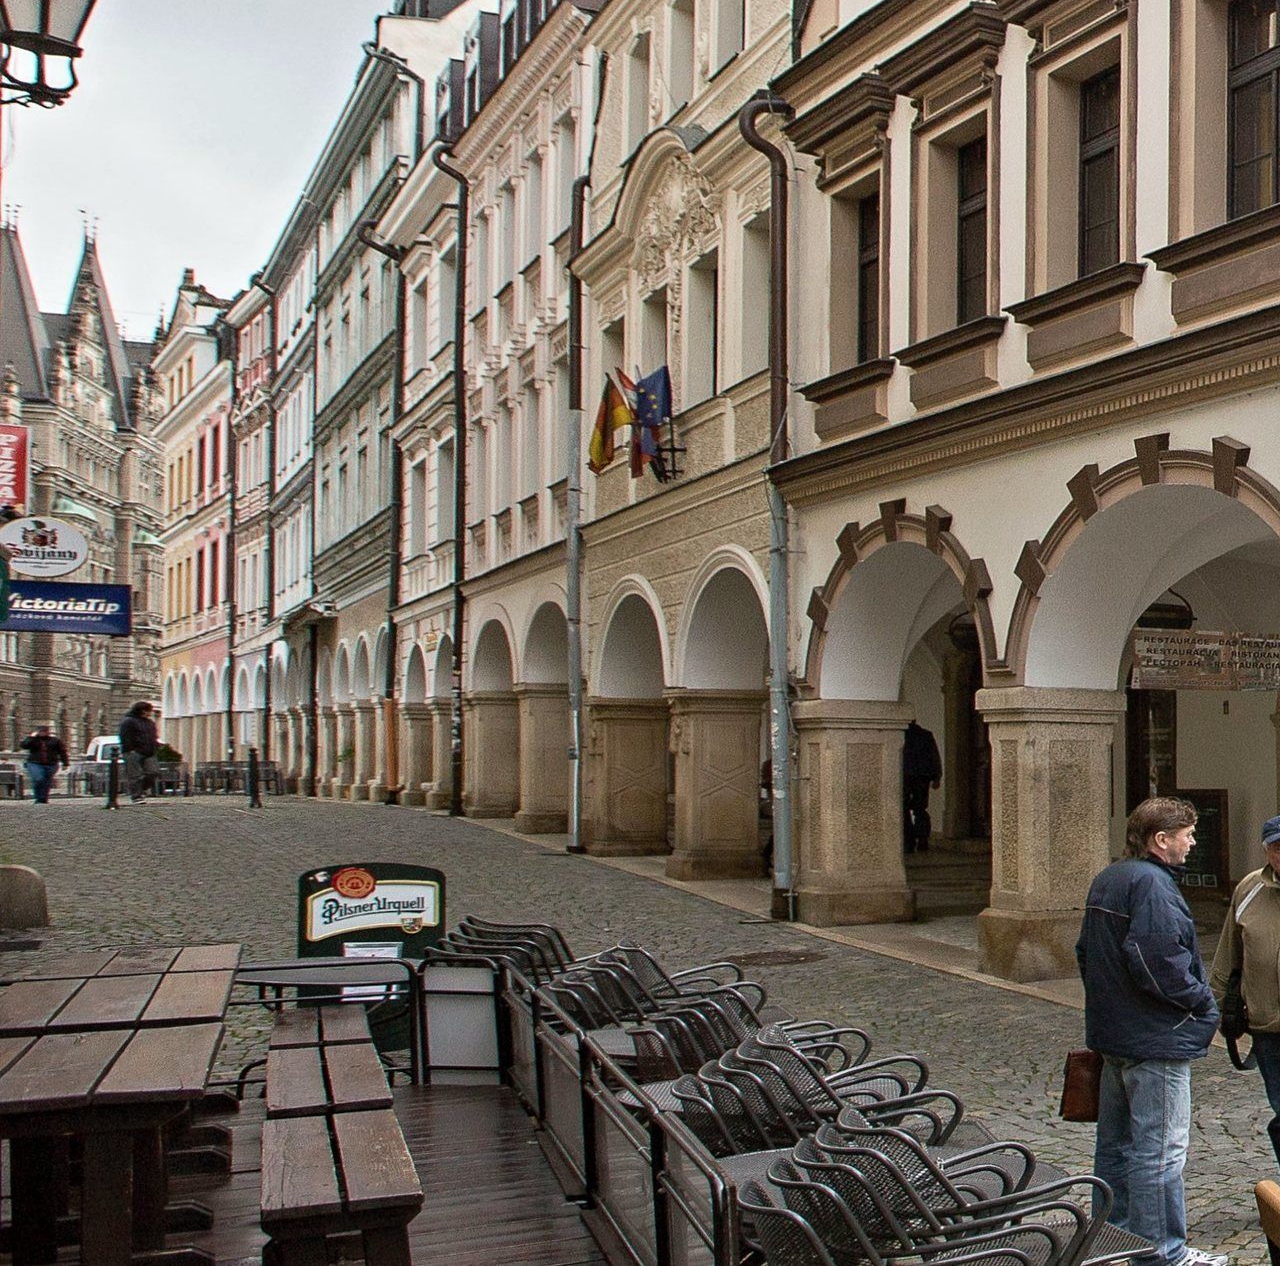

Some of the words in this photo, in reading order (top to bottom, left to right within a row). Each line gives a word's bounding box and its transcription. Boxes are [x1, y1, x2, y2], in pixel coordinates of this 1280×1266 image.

[1143, 636, 1209, 646] RESTAURACE
[322, 898, 377, 924] Pilsner
[375, 896, 426, 915] Urquell
